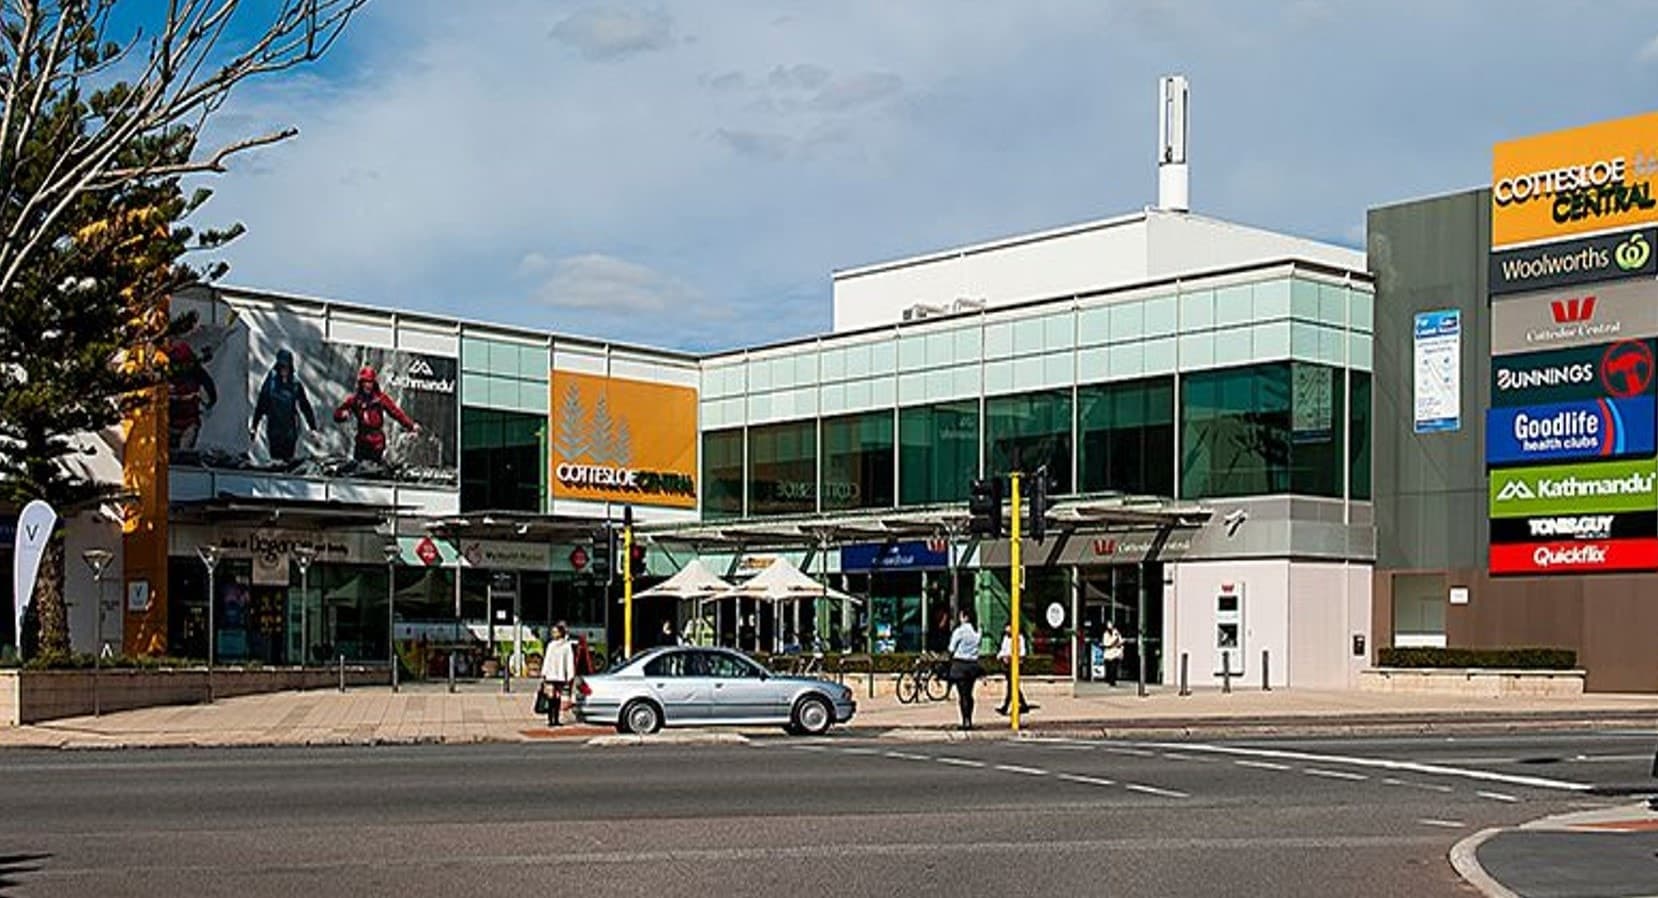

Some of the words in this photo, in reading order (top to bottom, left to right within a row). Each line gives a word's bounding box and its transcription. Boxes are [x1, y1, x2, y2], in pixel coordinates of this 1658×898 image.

[1494, 156, 1625, 205] COTTESLOE
[1553, 181, 1656, 223] CENTRAL
[1502, 247, 1609, 281] Woolworths
[1578, 321, 1621, 337] Central
[1497, 364, 1593, 390] BUNNINGS
[1515, 411, 1599, 440] Goodlife
[1523, 439, 1562, 452] health
[1563, 436, 1599, 449] clubs
[557, 463, 640, 492] COTTESLOE
[1538, 473, 1652, 498] Kathmandu
[1533, 545, 1606, 567] Quickflix
